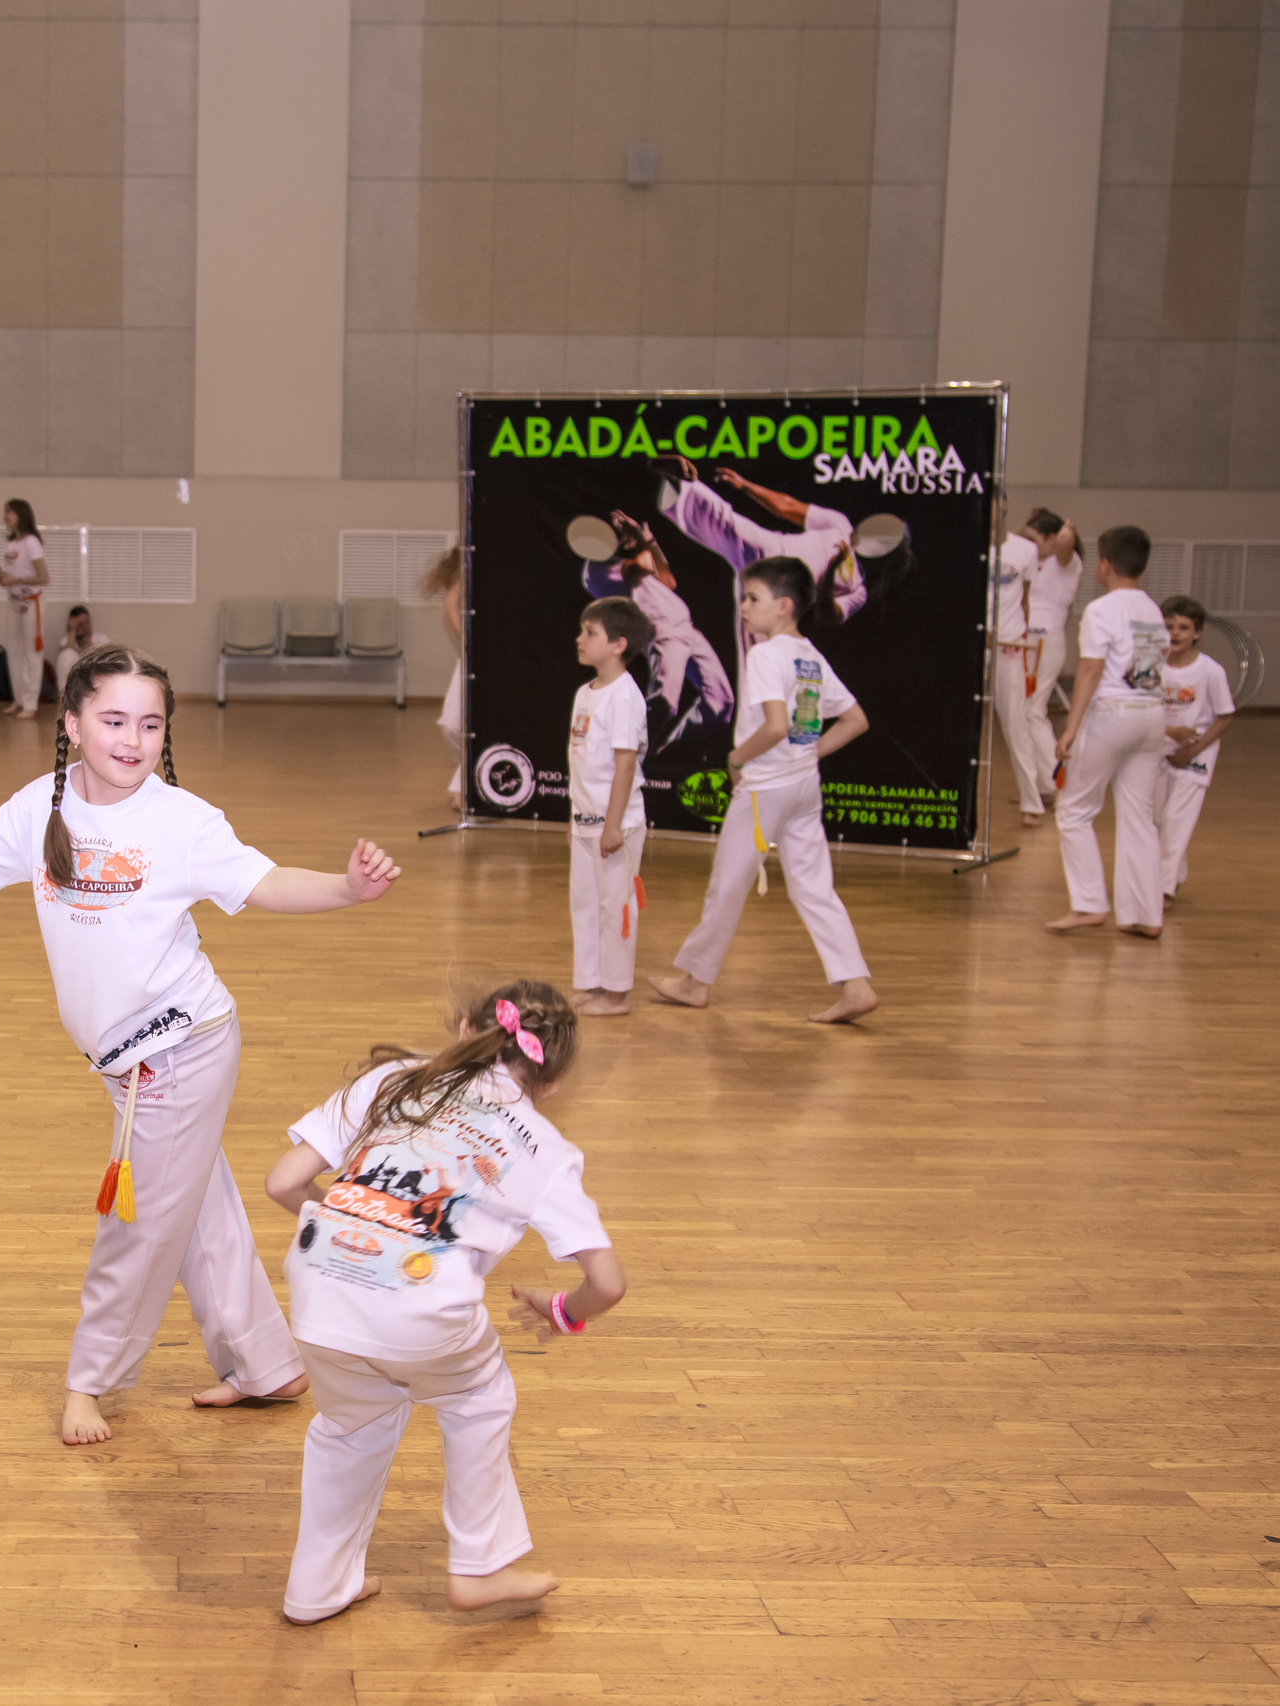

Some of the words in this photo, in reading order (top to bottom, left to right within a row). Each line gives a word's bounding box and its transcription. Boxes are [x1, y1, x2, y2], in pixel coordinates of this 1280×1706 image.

[489, 403, 943, 459] ABADÁ-CAPOEIRA
[814, 444, 967, 484] SAMARA
[881, 471, 984, 494] RUSSIA
[538, 771, 563, 781] РОО
[643, 779, 672, 789] стная
[538, 784, 569, 796] федер
[821, 782, 959, 801] APOEIRA-SAMARA.RU
[849, 809, 878, 825] 906
[882, 811, 910, 827] 346
[914, 813, 934, 828] 46
[938, 815, 957, 830] 33
[70, 879, 135, 892] Á-CAPOEIRA
[70, 912, 102, 925] RÚSSIA
[473, 1095, 539, 1155] APOEIRA
